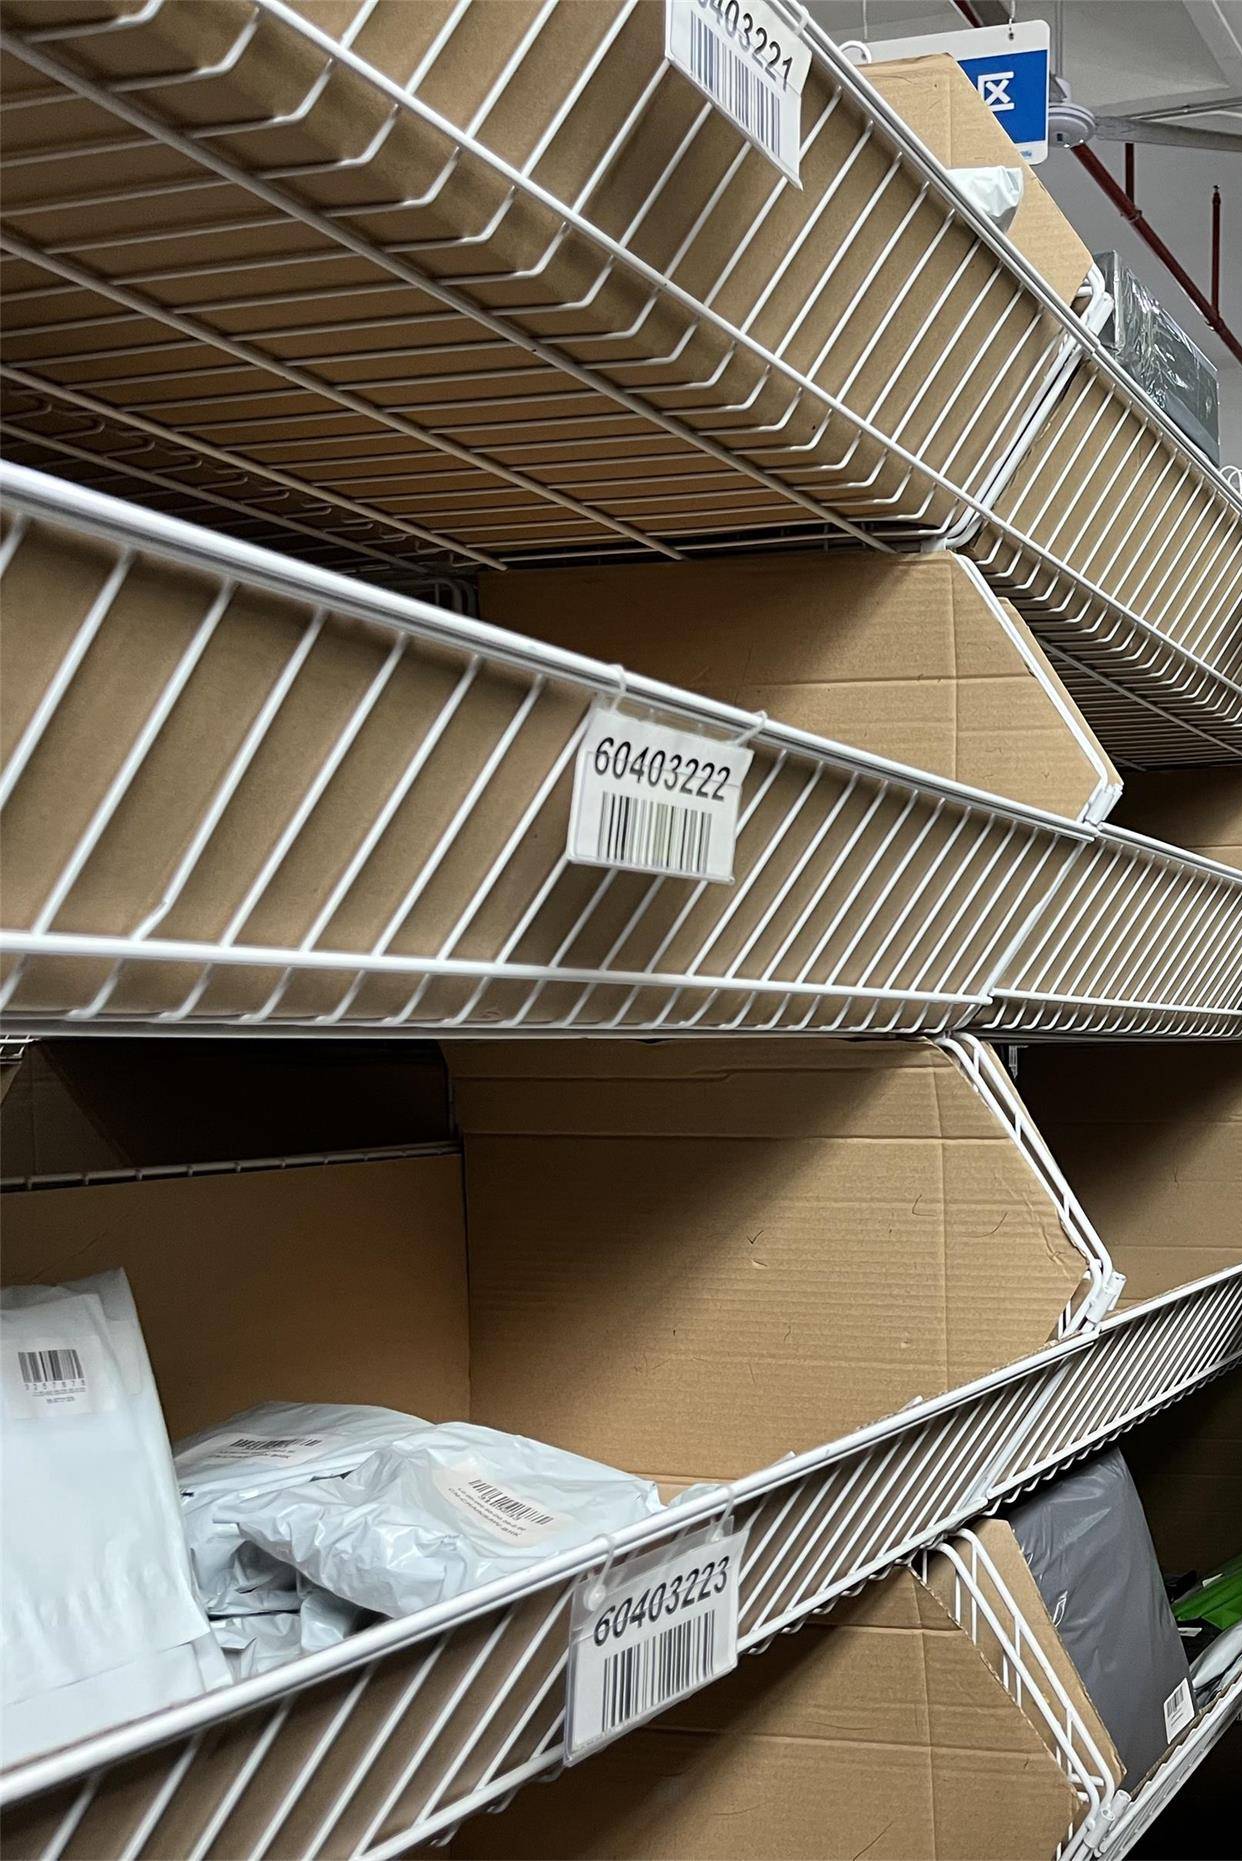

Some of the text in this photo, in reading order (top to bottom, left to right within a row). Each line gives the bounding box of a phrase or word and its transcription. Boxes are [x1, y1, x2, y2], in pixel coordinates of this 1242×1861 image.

[978, 71, 1014, 112] 区
[594, 737, 731, 802] 60403222
[594, 1555, 729, 1647] 60403223
